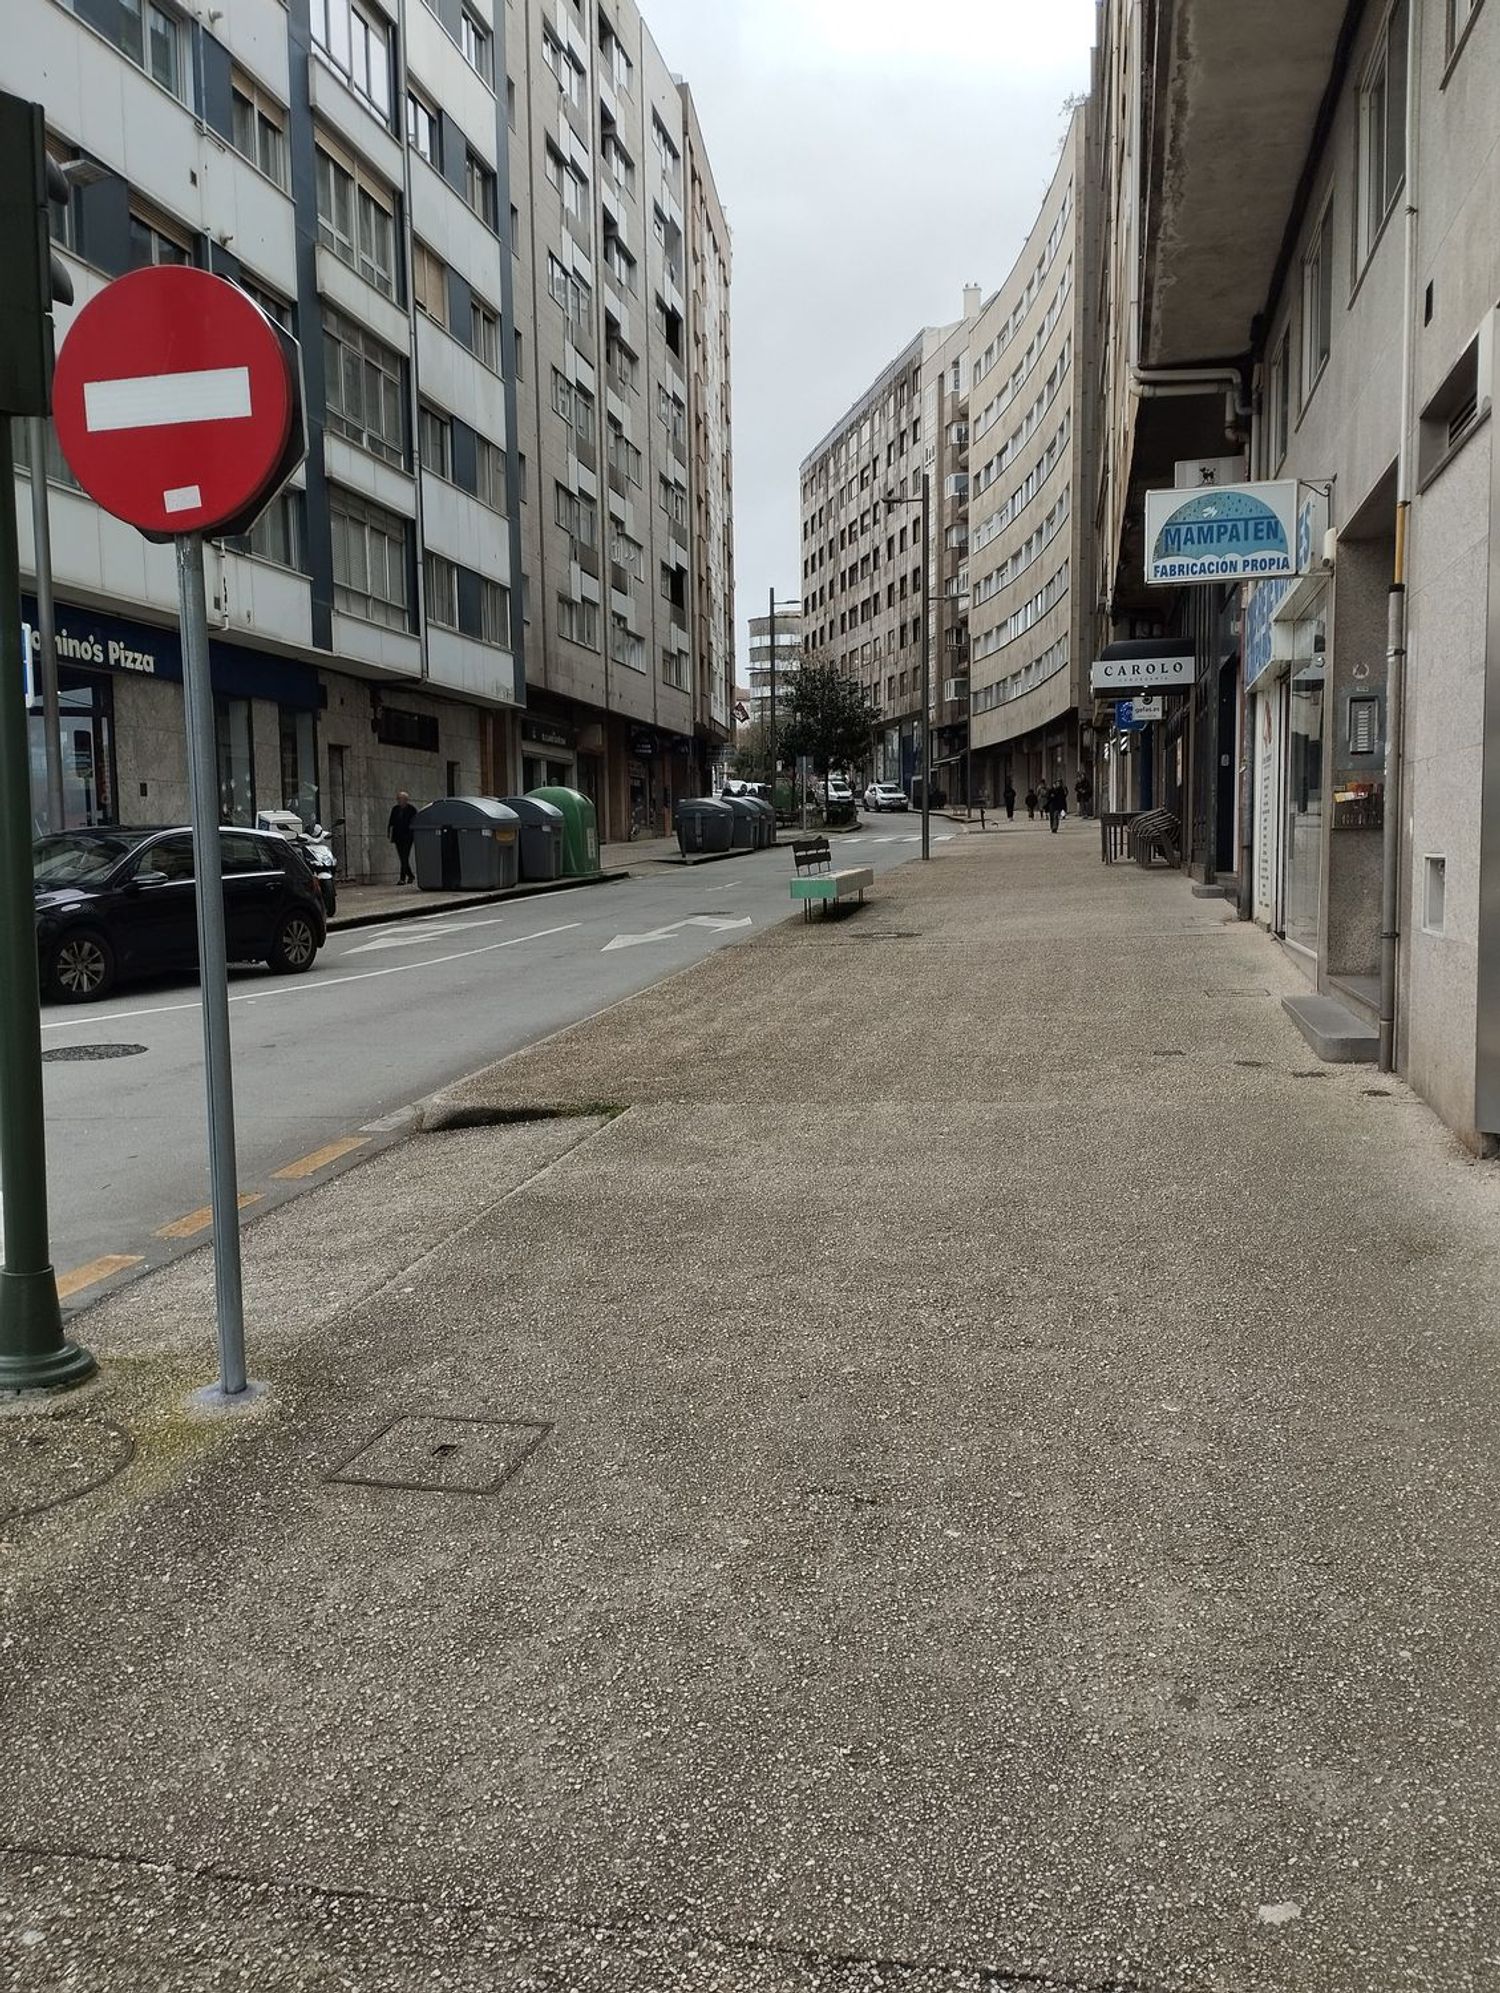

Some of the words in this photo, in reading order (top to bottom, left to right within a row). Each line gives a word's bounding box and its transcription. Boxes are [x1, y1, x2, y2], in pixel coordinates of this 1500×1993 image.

[1242, 556, 1290, 572] PROPIA
[107, 640, 155, 673] Pizza
[1103, 661, 1184, 677] CAROLO
